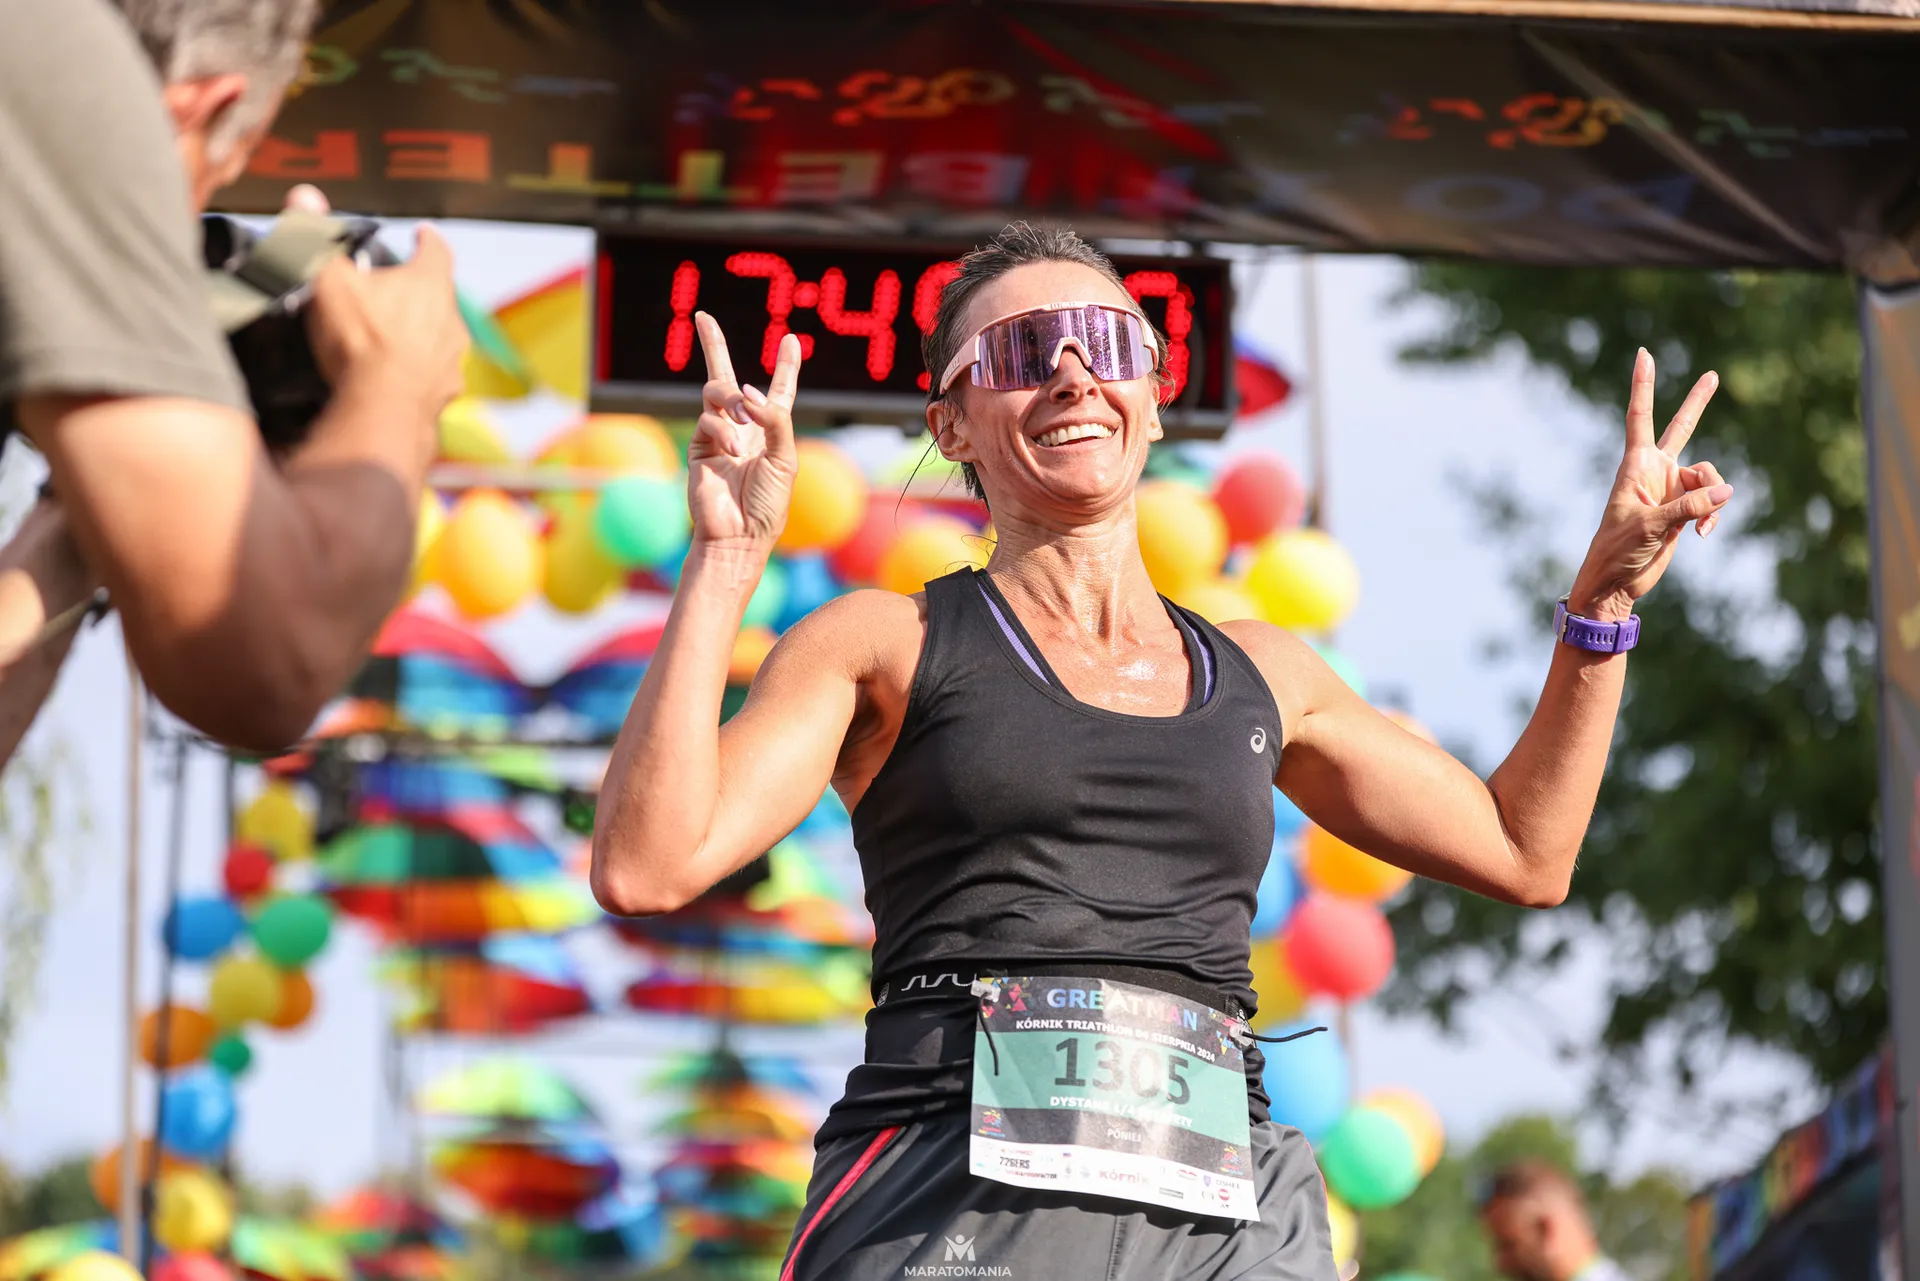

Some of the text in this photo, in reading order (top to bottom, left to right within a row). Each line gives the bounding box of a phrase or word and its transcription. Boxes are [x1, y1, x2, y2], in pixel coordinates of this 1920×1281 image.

[1047, 988, 1198, 1031] GREATMAN
[1016, 1017, 1063, 1029] KÓRNIK
[1066, 1020, 1134, 1037] TRIATHLON
[1151, 1031, 1196, 1054] SIERPNIA
[1197, 1047, 1216, 1062] 2024
[1054, 1037, 1191, 1106] 1305
